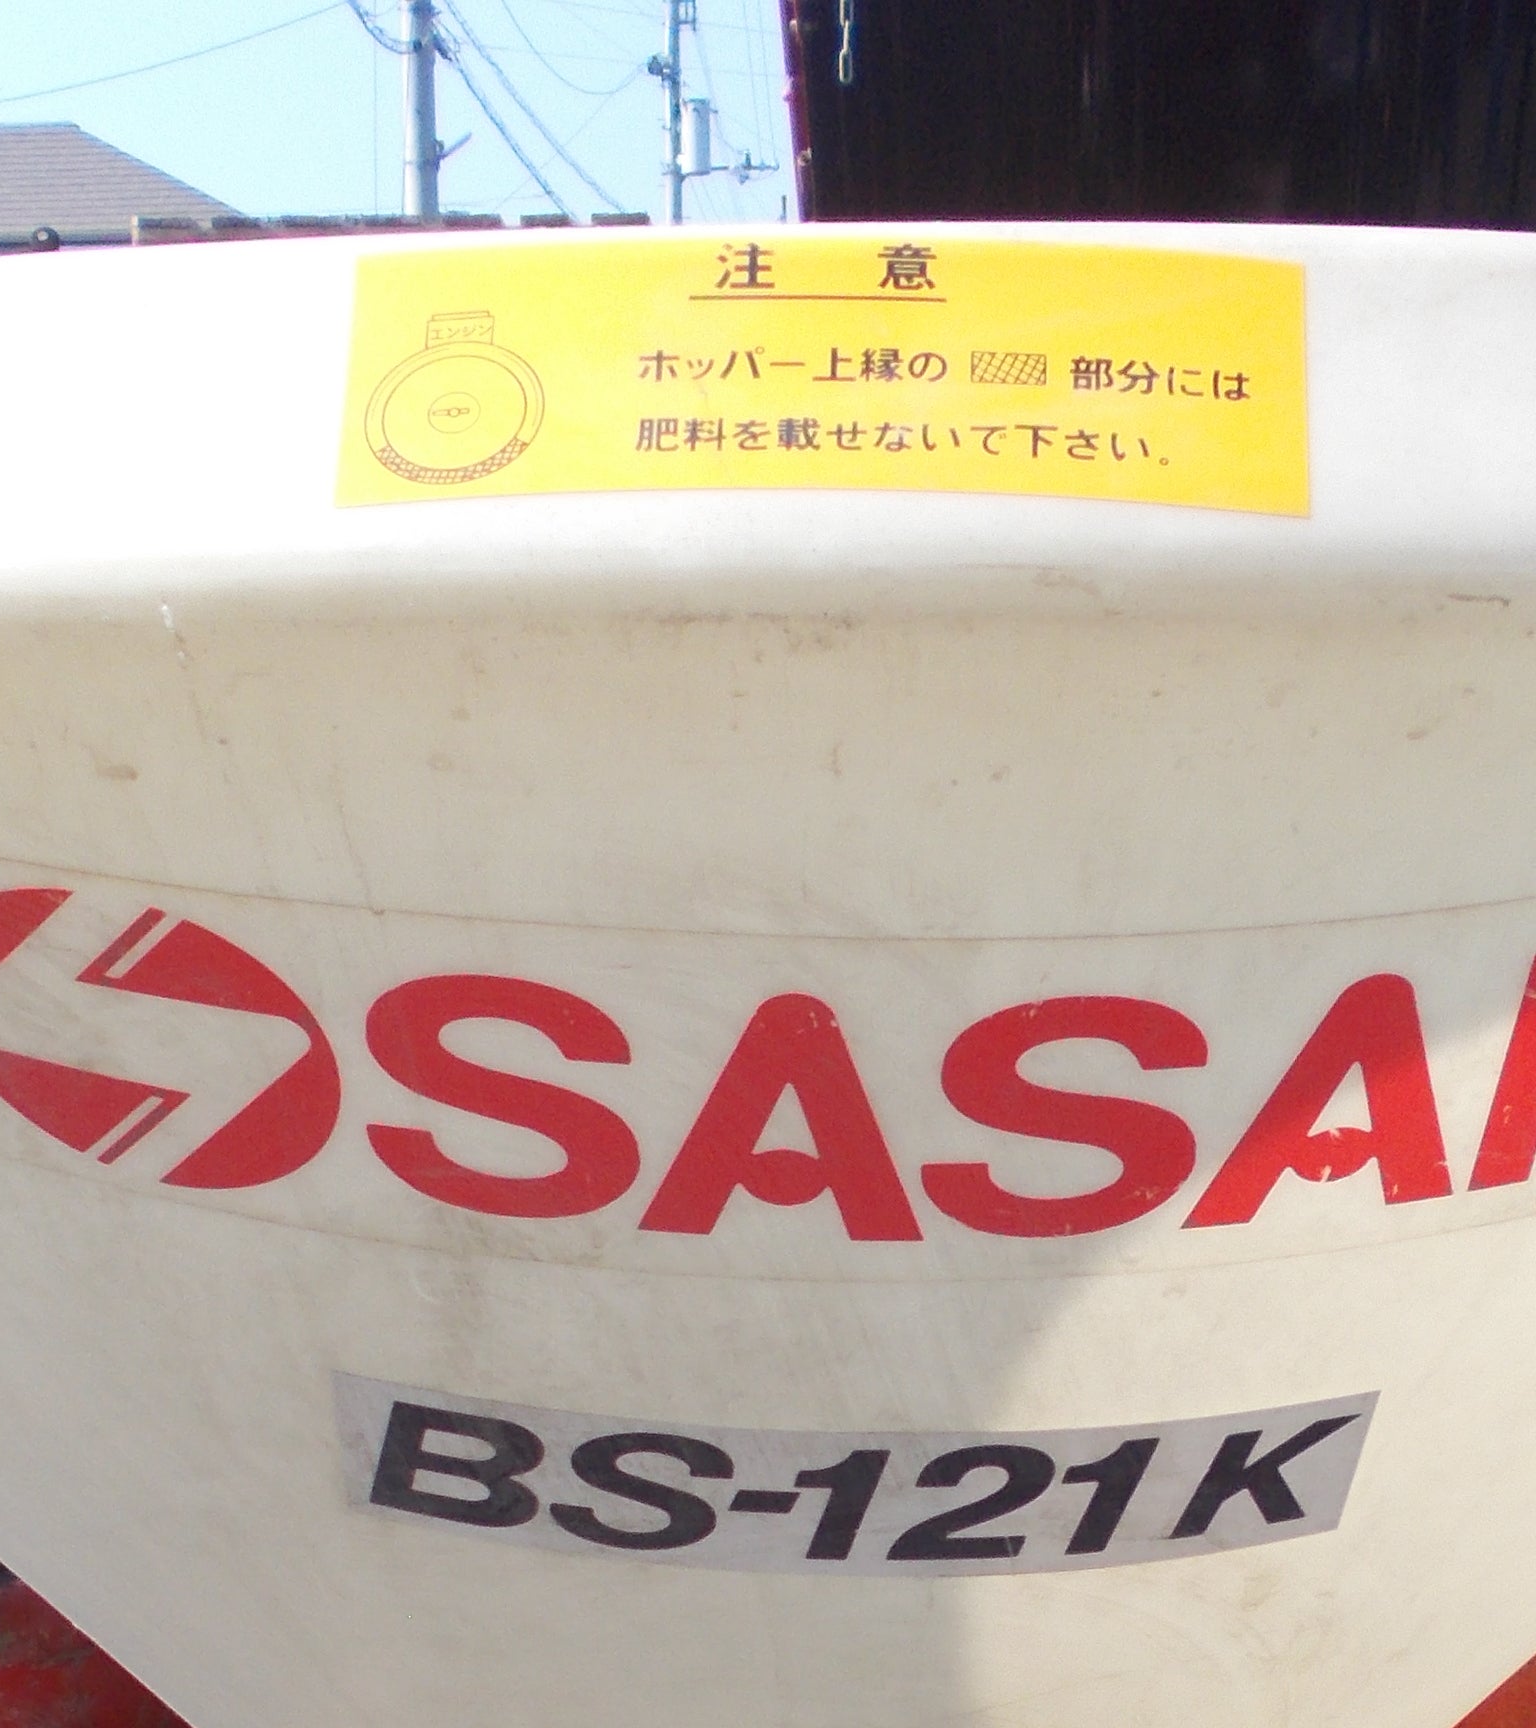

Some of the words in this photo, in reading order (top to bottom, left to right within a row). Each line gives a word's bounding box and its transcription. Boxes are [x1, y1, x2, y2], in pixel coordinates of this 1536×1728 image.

[430, 322, 494, 341] エンジン
[636, 346, 950, 387] ホッパー上縁の
[1068, 355, 1252, 403] 部分には
[634, 415, 1172, 467] 肥料を載せないで下さい。
[368, 1398, 1363, 1563] BS-121K
